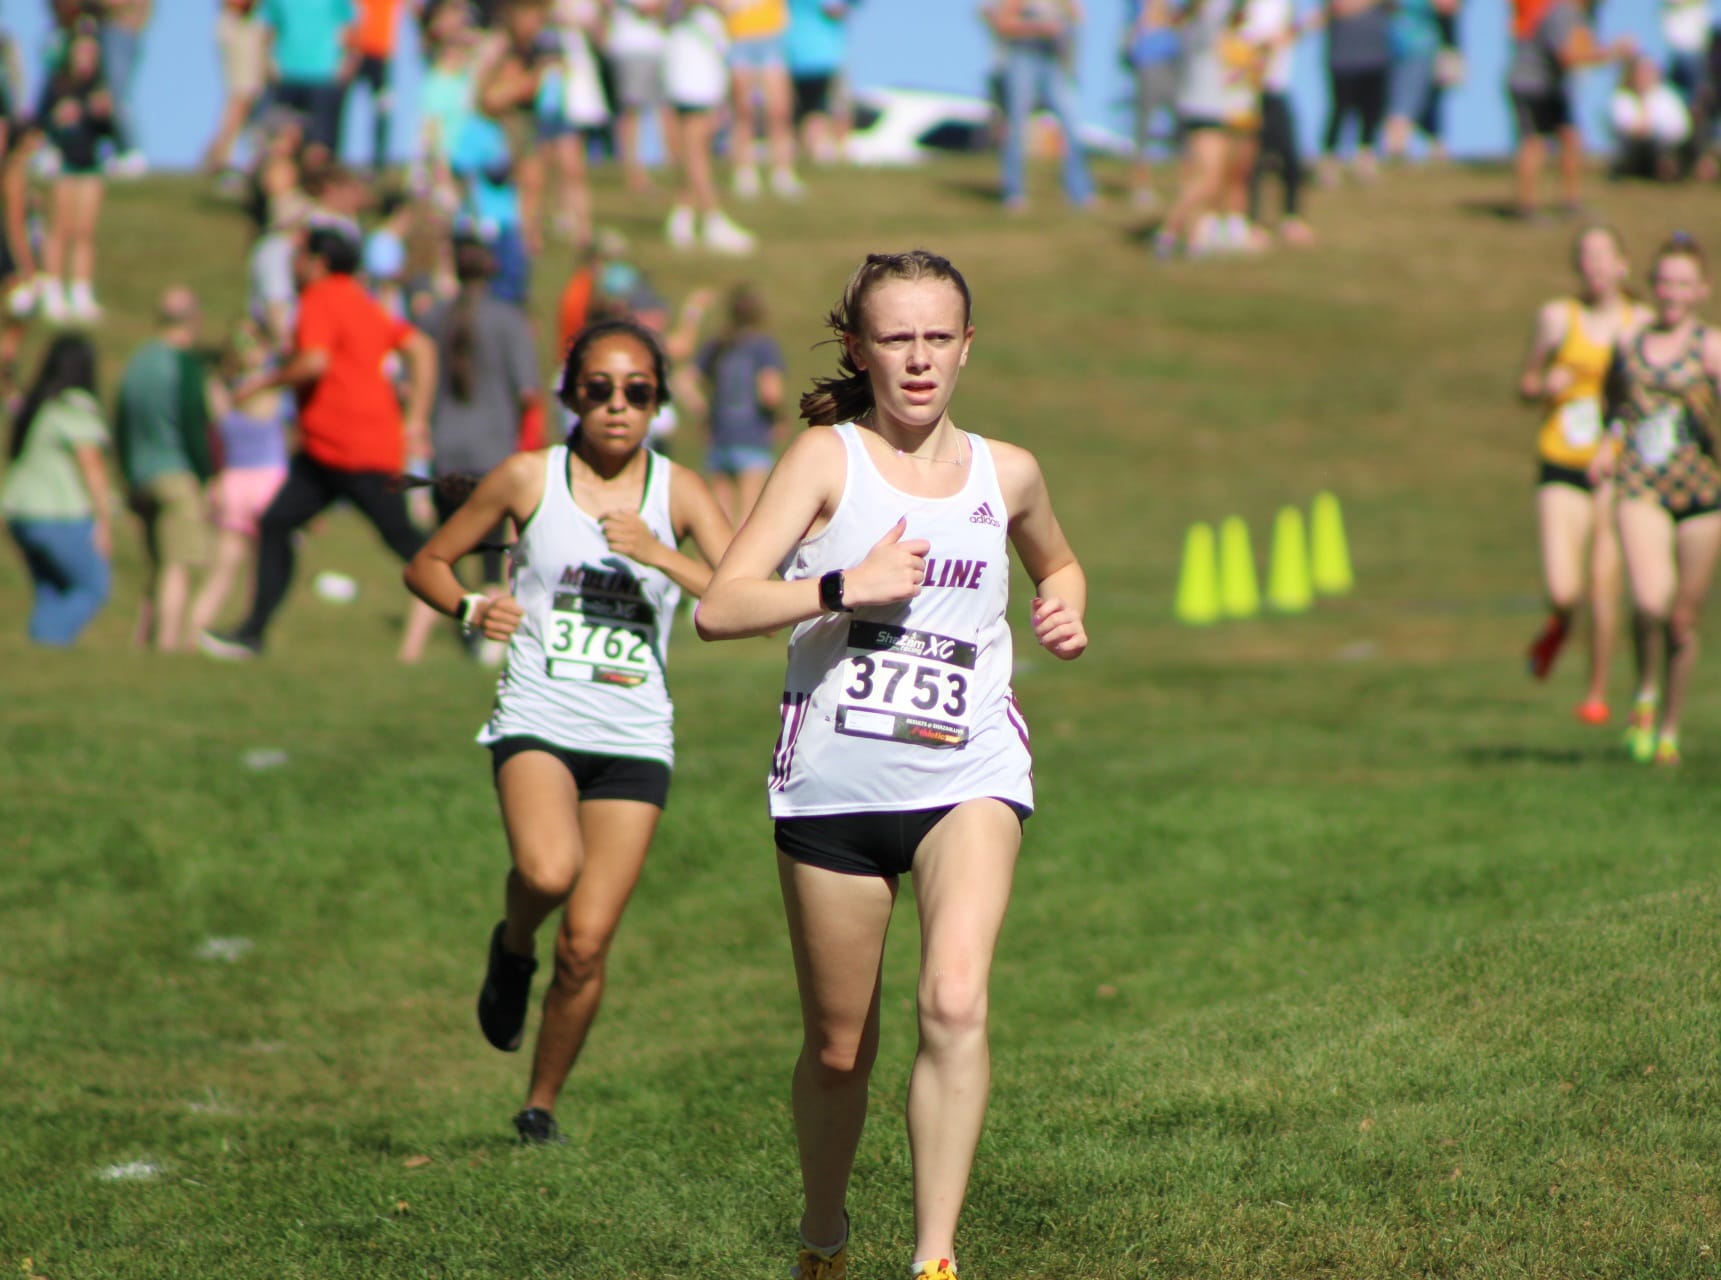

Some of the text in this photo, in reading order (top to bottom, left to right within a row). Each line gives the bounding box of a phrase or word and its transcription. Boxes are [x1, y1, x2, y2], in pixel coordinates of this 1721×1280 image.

[969, 515, 1000, 528] adidas
[921, 558, 988, 590] LINE
[551, 618, 649, 664] 3762
[922, 635, 956, 660] XC
[846, 655, 968, 718] 3753
